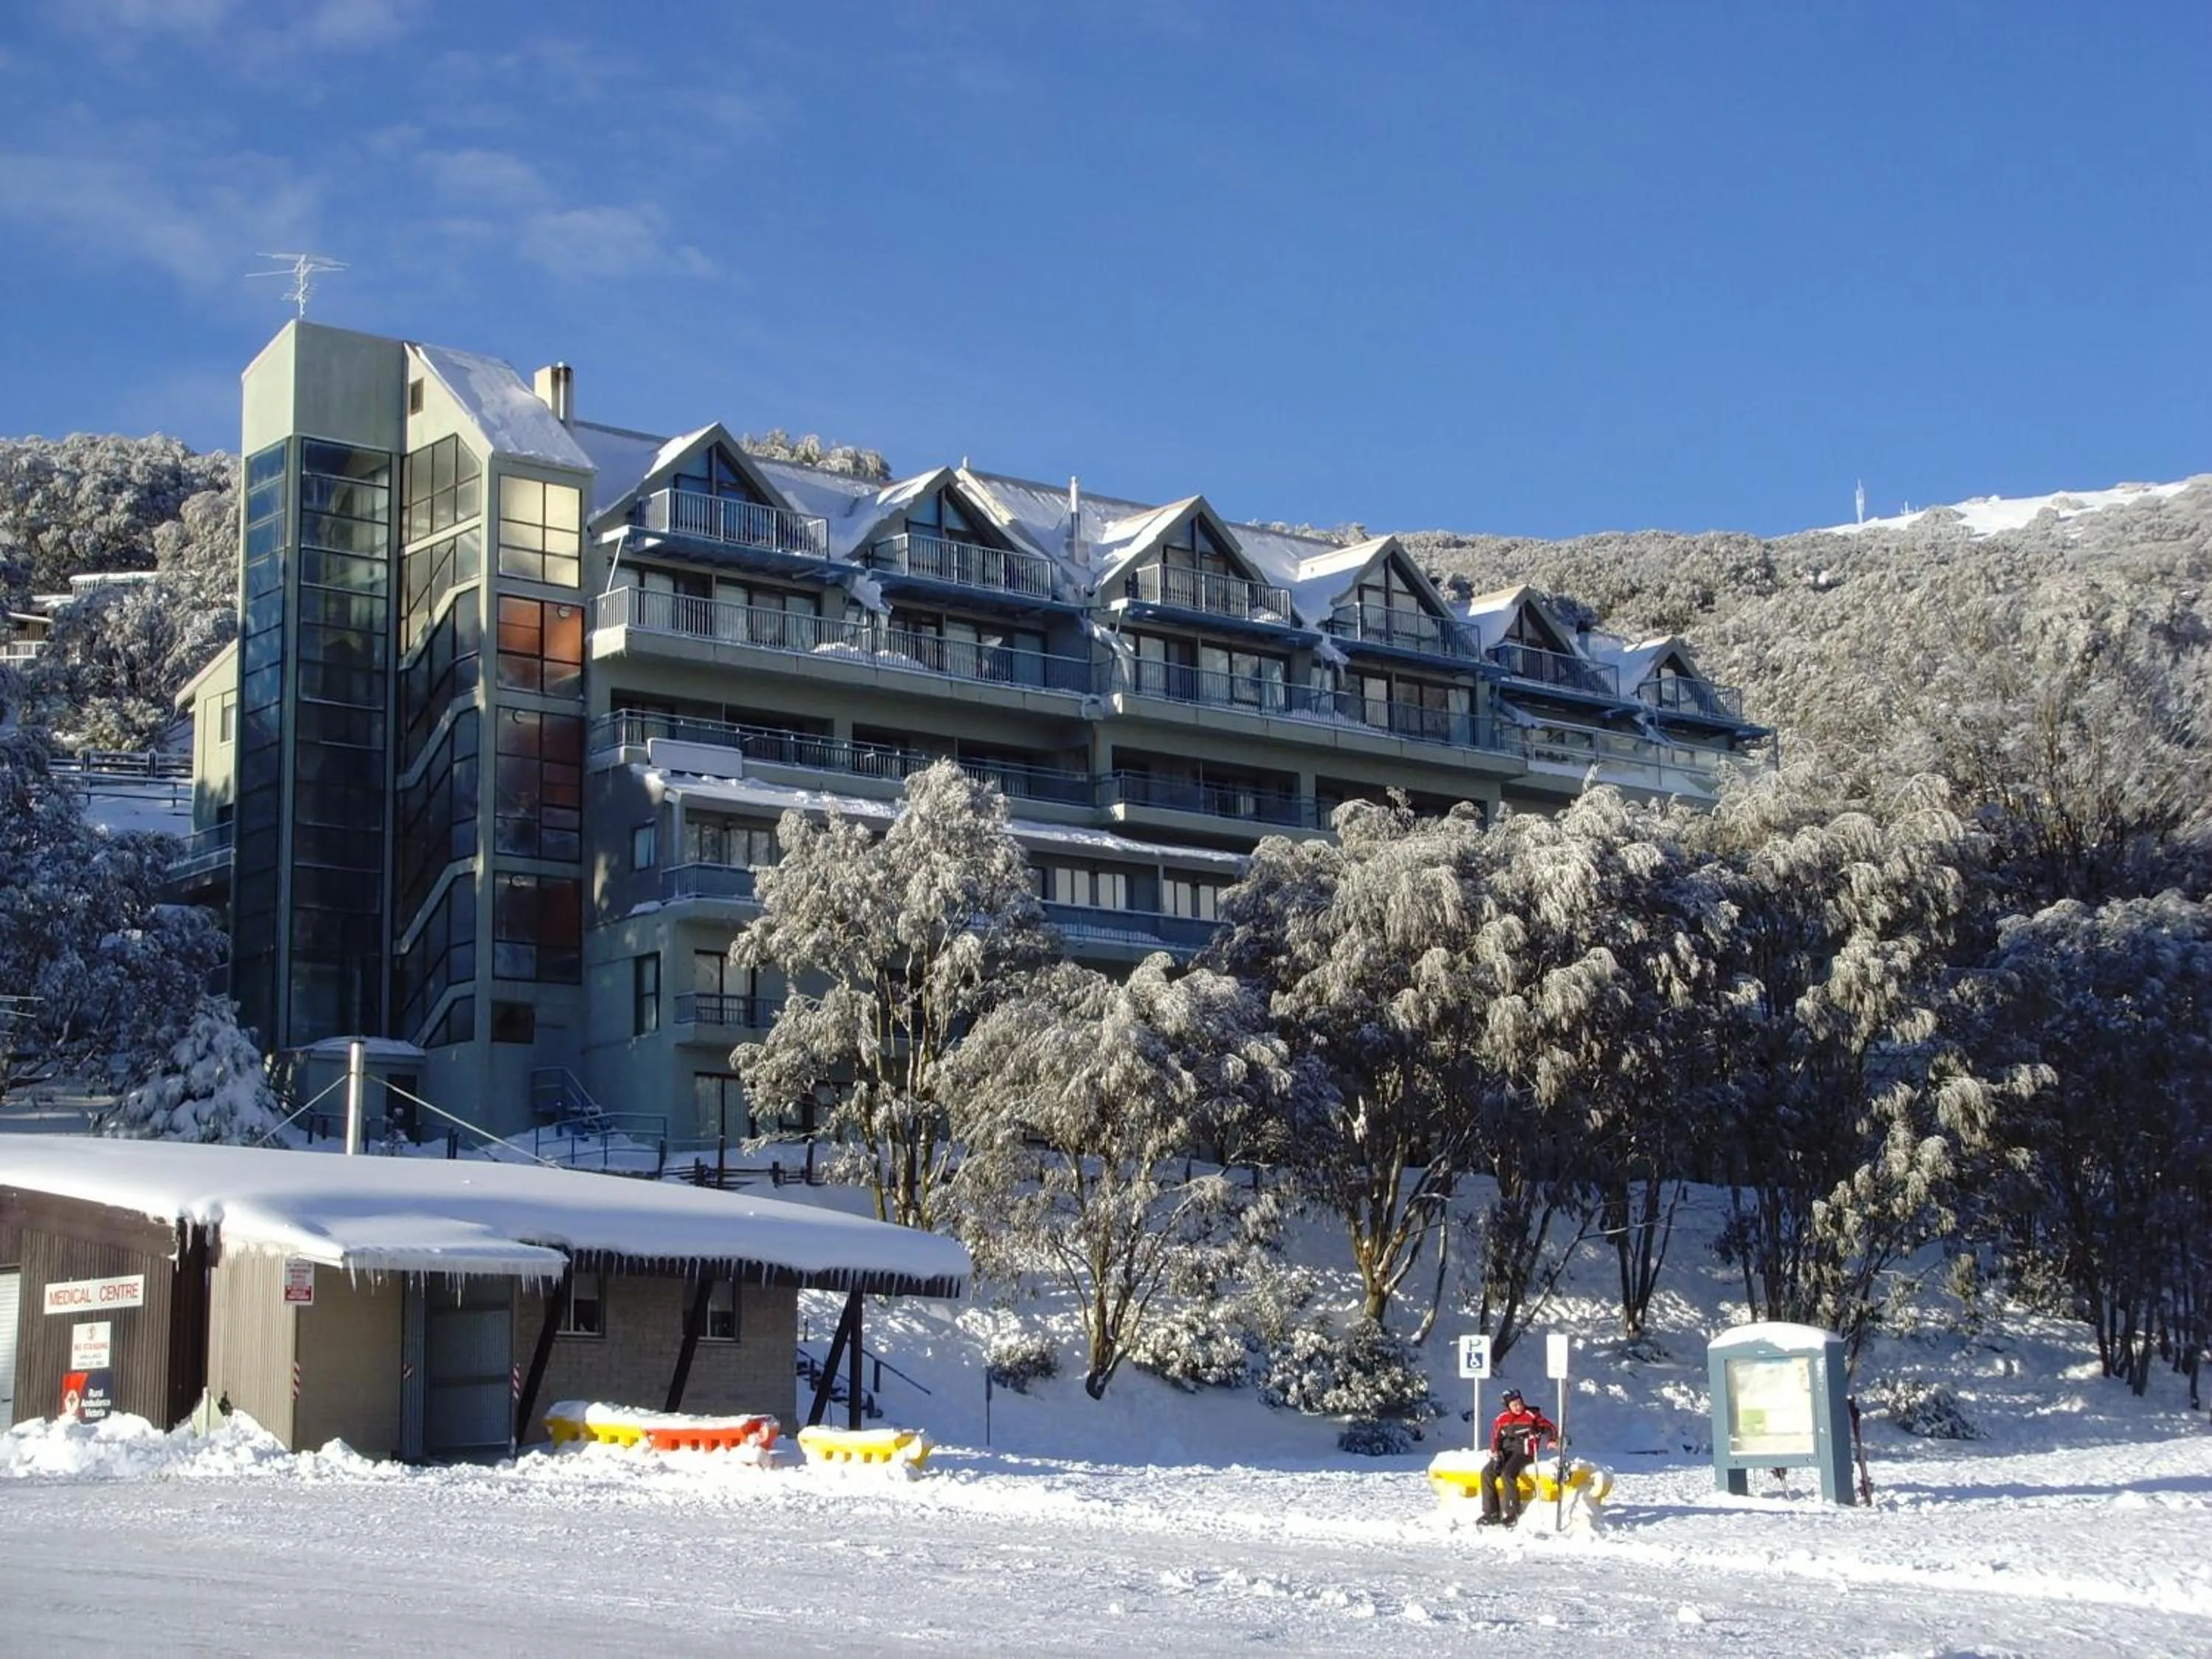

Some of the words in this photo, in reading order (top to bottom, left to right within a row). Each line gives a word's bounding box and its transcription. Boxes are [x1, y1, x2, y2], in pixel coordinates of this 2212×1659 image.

[49, 1287, 91, 1306] MEDICAL
[100, 1282, 139, 1301] CENTRE
[1469, 1338, 1481, 1351] P
